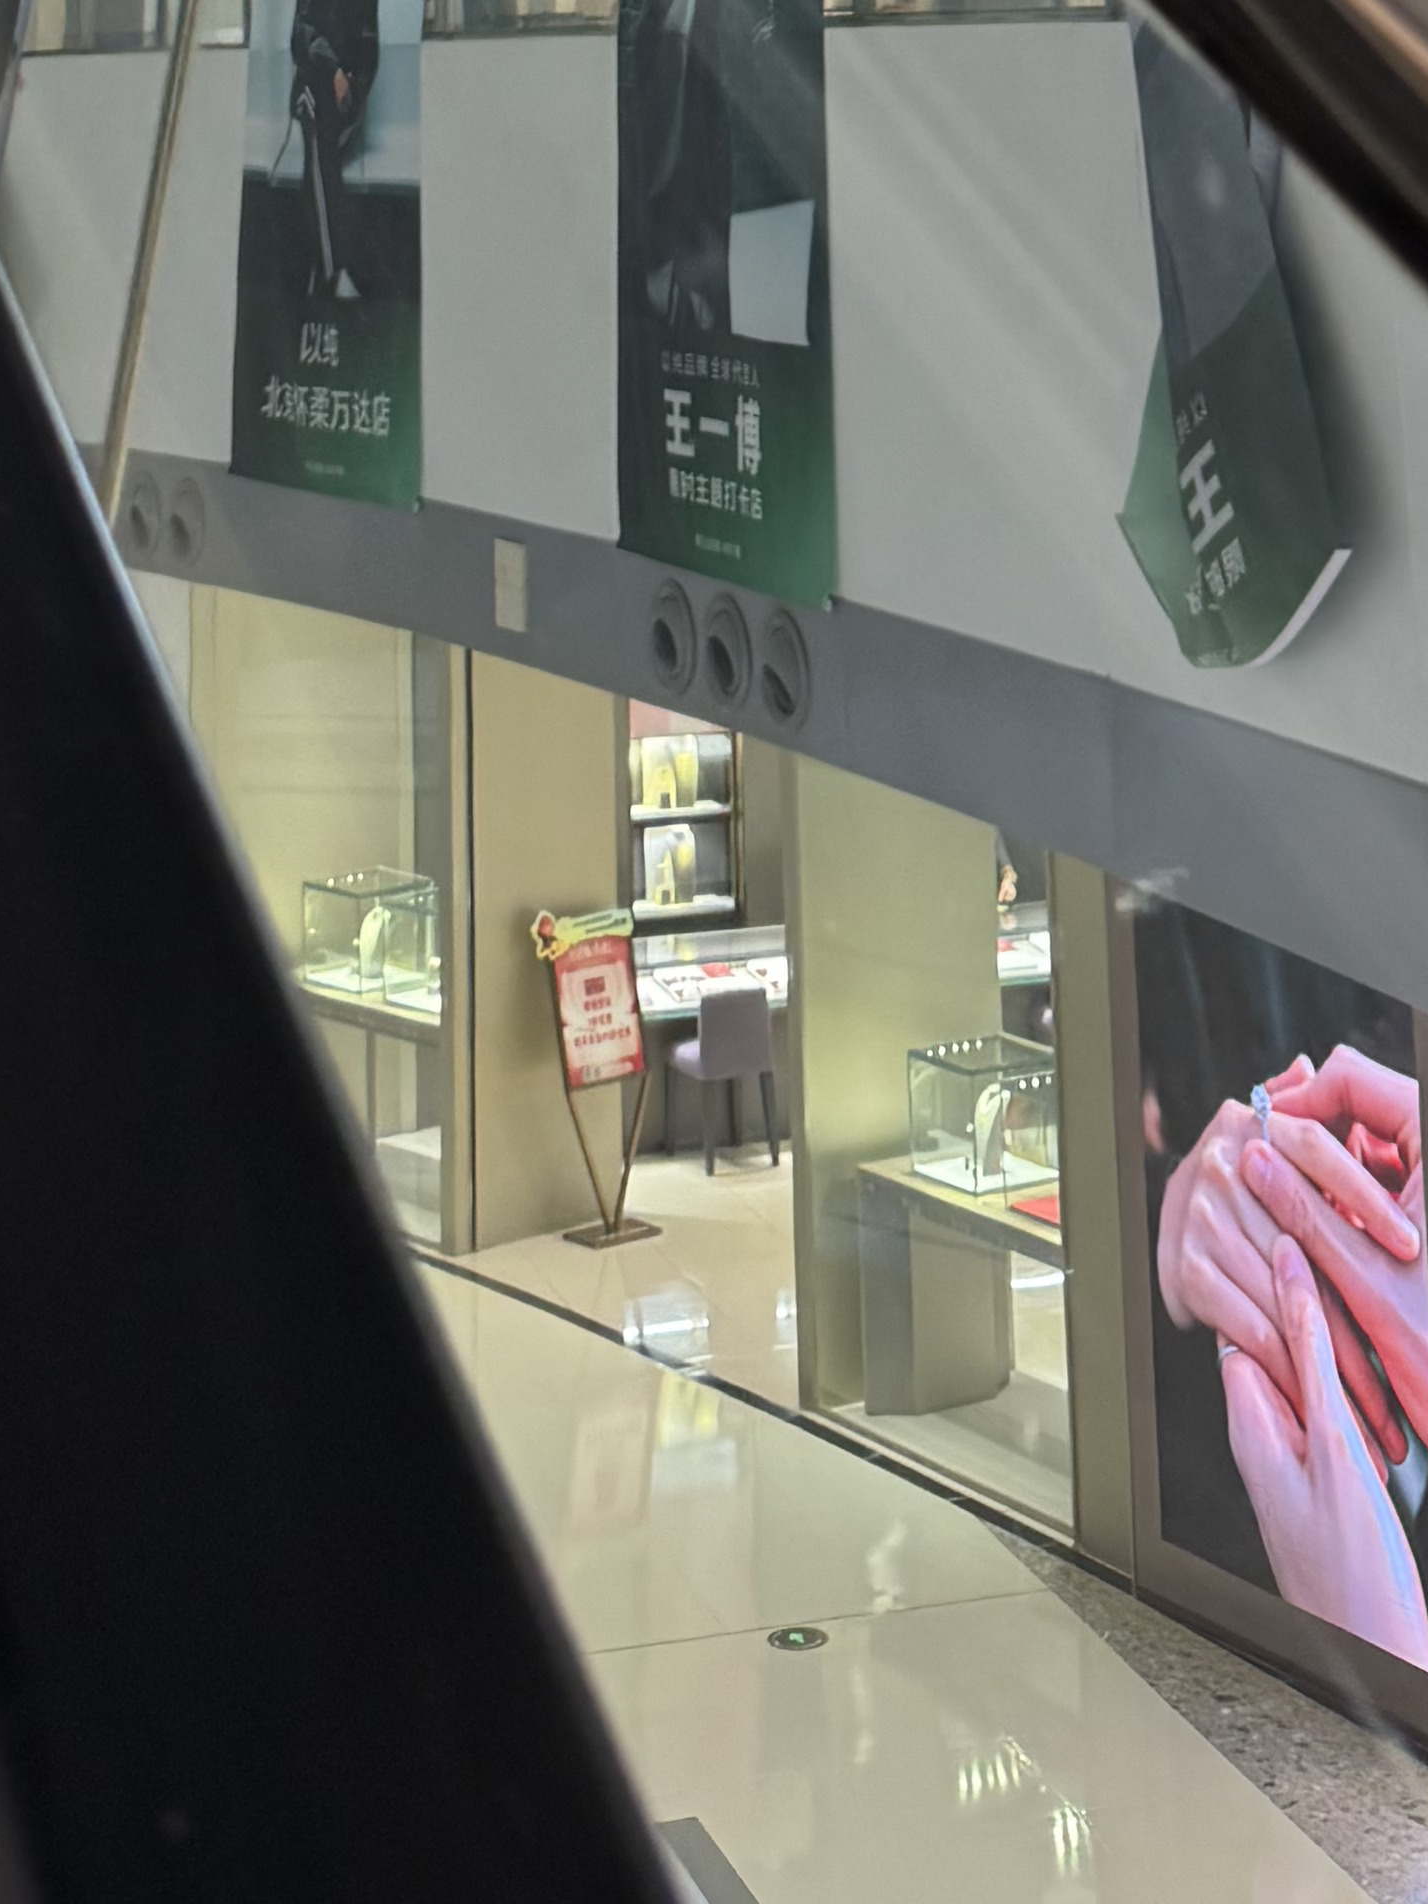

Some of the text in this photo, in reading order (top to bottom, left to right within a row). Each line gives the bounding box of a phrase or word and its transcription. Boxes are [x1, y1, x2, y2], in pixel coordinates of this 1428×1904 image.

[300, 323, 340, 367] 以纯
[260, 375, 391, 437] 北京怀柔万达店
[663, 388, 761, 476] 王一博
